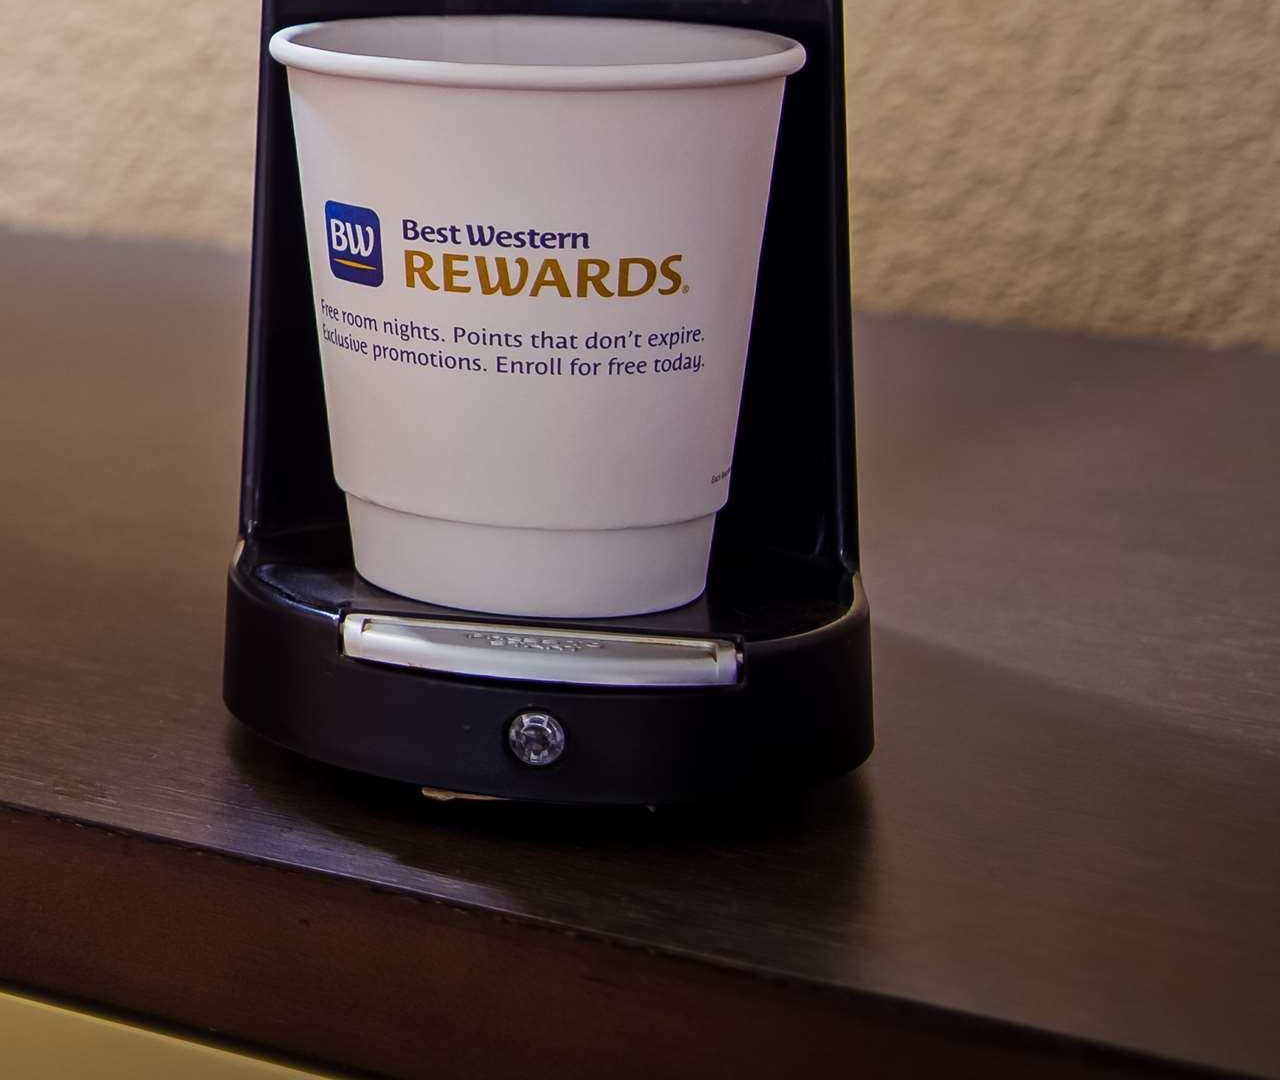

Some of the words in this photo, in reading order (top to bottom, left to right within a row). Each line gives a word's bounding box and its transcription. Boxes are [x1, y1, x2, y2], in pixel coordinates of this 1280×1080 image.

[330, 218, 376, 258] BW
[402, 219, 462, 245] Best
[467, 224, 589, 249] Western
[320, 298, 340, 321] Free
[341, 310, 378, 332] room
[383, 318, 446, 343] nights.
[453, 325, 524, 349] Points
[530, 330, 579, 350] that
[647, 325, 705, 350] expire.
[322, 323, 368, 355] Exclusive
[372, 342, 488, 372] promotions.
[496, 355, 563, 376] Enroll
[570, 357, 602, 376] for
[607, 357, 648, 376] free
[653, 352, 705, 373] today.
